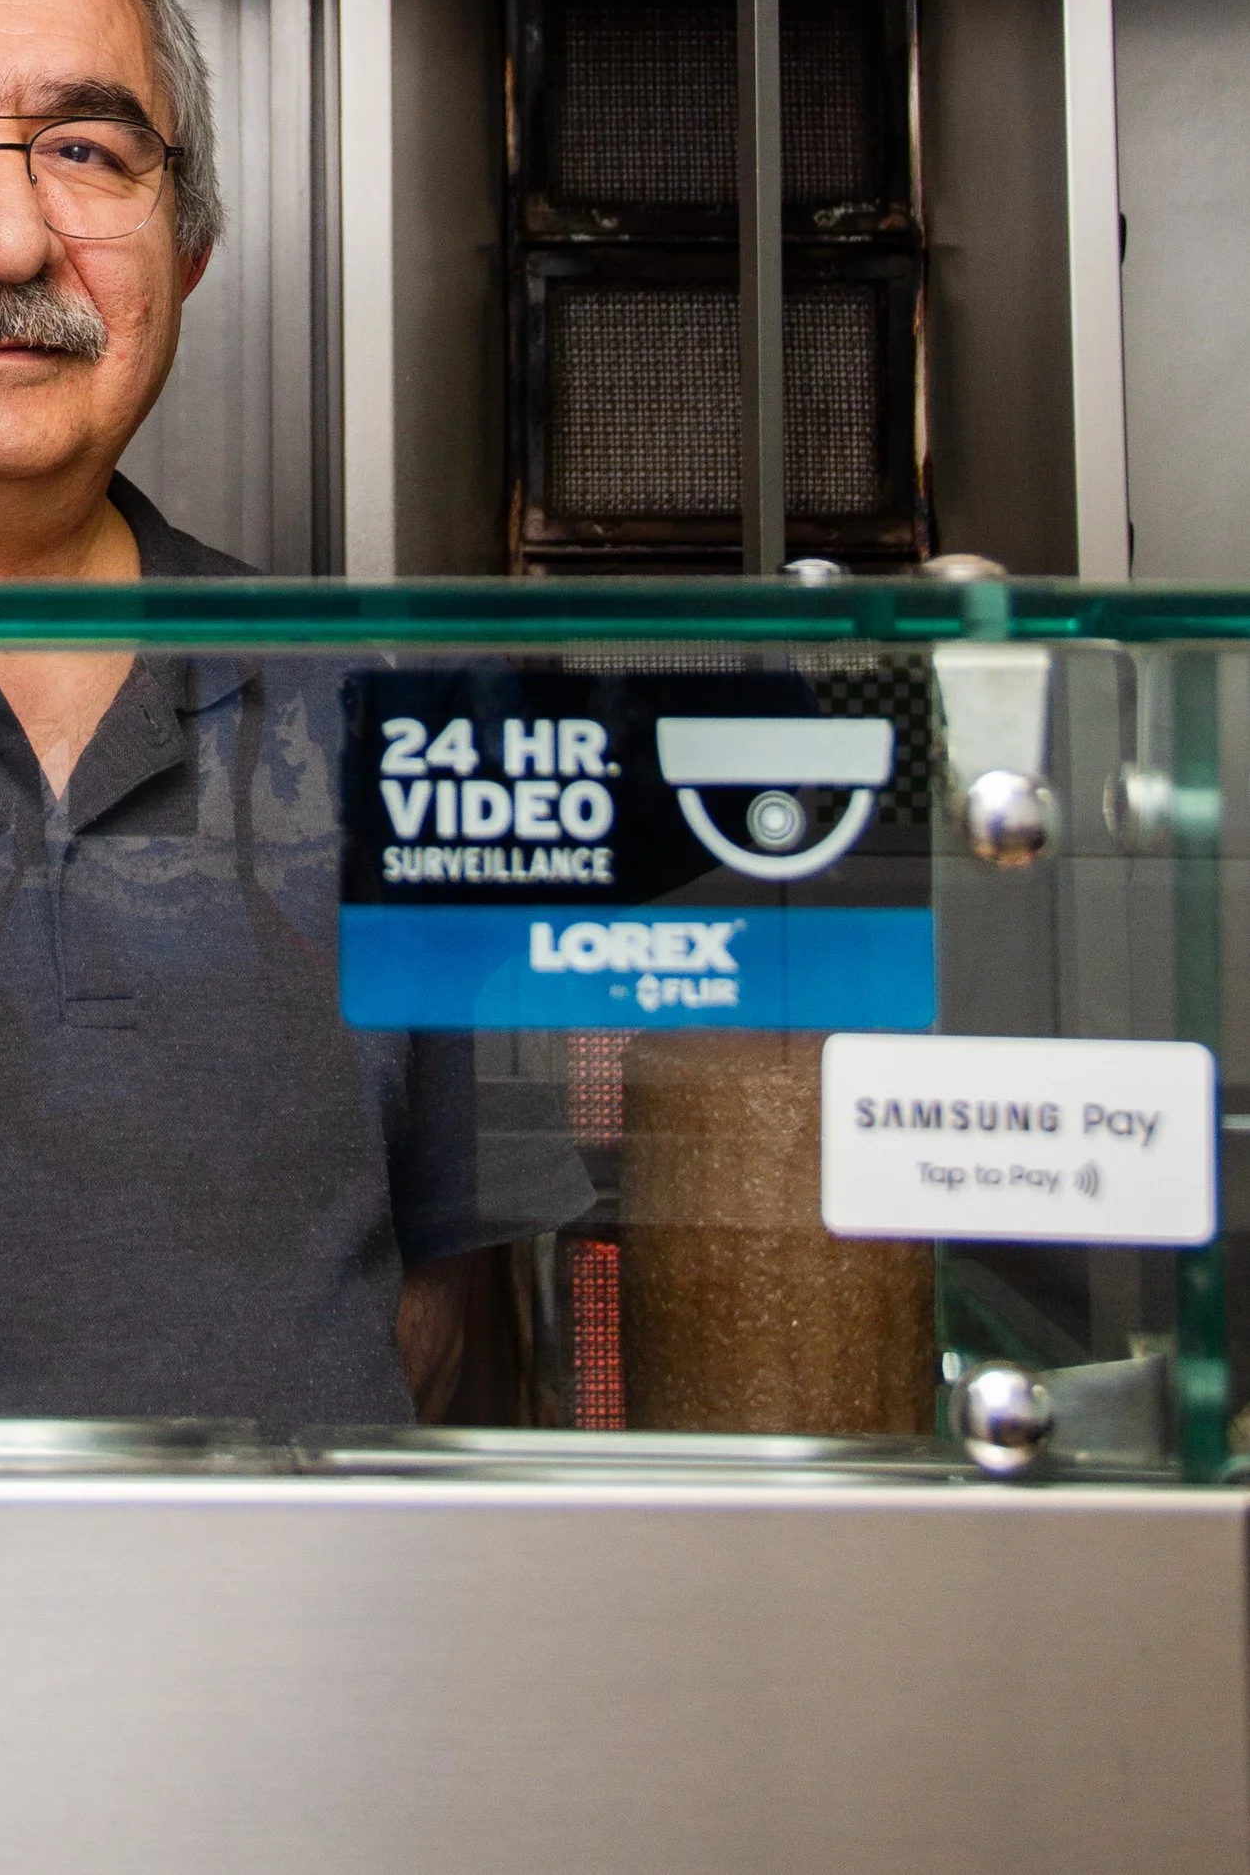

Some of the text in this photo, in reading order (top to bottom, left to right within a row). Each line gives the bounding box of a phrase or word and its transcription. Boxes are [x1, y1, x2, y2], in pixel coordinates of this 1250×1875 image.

[380, 717, 621, 777] 24 HR.
[380, 780, 615, 841] VIDEO
[382, 846, 615, 884] SURVEILLANCE
[529, 922, 739, 972] LOREX
[855, 1097, 1161, 1147] SAMSUNG Pay
[918, 1161, 1061, 1192] Tap to Pay
